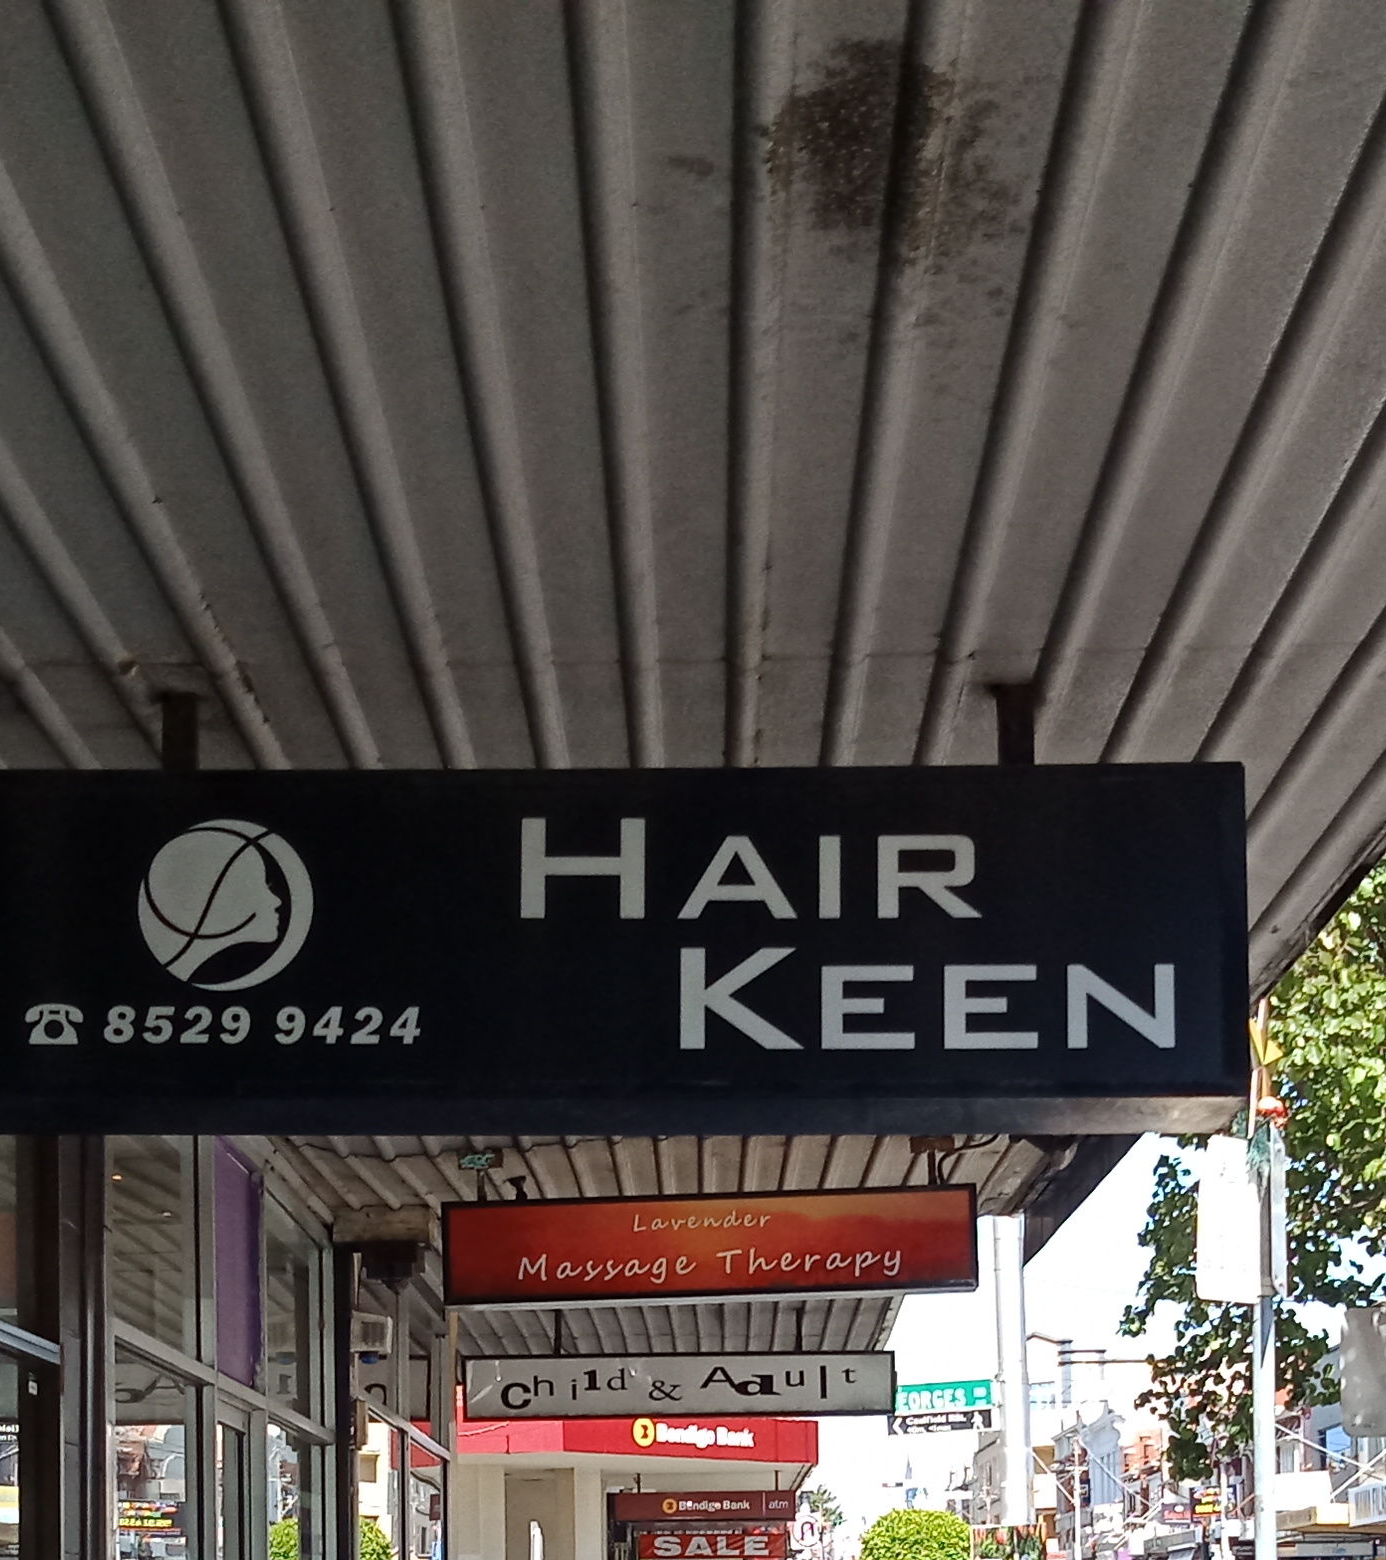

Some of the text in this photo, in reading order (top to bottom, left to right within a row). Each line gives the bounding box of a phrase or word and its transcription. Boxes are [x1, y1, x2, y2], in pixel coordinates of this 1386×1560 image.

[519, 815, 984, 922] HAIR
[678, 944, 1177, 1052] KEEN
[101, 1005, 424, 1046] 8529 9424
[632, 1210, 772, 1233] Lavender
[517, 1245, 903, 1285] Massage Therapy
[500, 1364, 857, 1410] Child & Adult
[655, 1421, 755, 1448] Bendigo Bank
[722, 1499, 750, 1511] Bank
[652, 1535, 770, 1557] SALE
